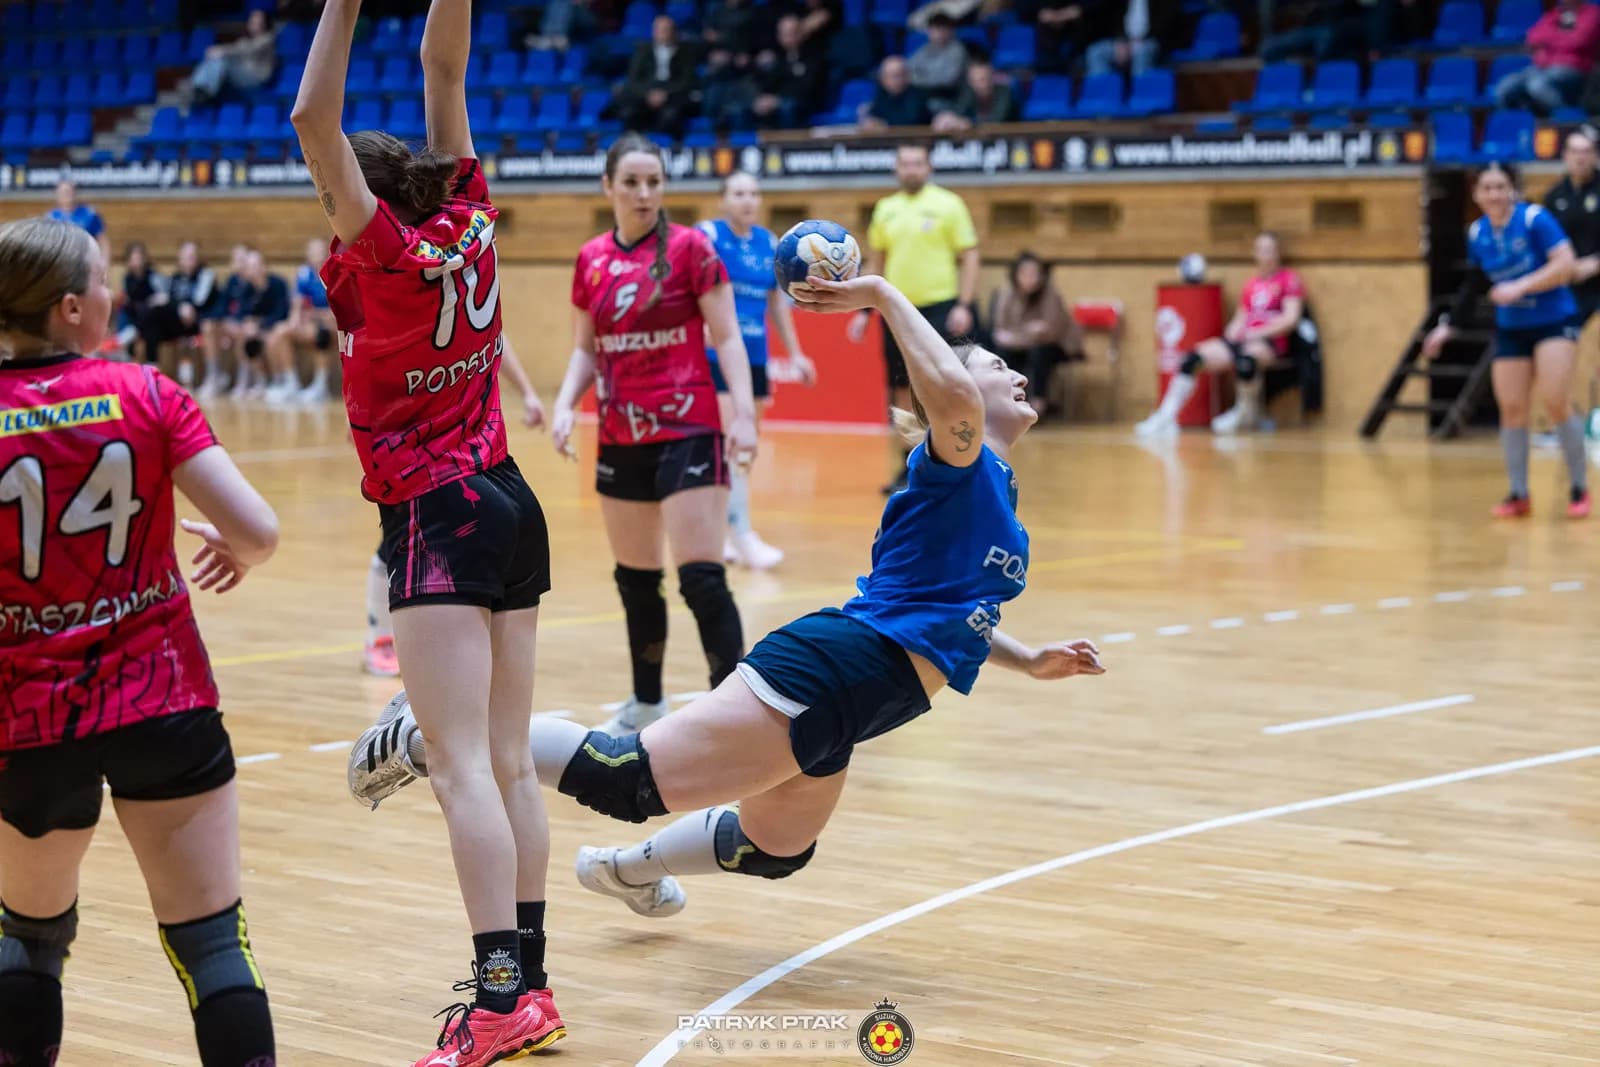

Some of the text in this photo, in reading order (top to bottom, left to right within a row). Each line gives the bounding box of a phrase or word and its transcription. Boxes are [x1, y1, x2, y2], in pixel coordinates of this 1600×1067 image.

[422, 220, 500, 349] 10
[612, 282, 639, 322] 5
[602, 326, 688, 354] SUZUKI
[0, 441, 143, 582] 14
